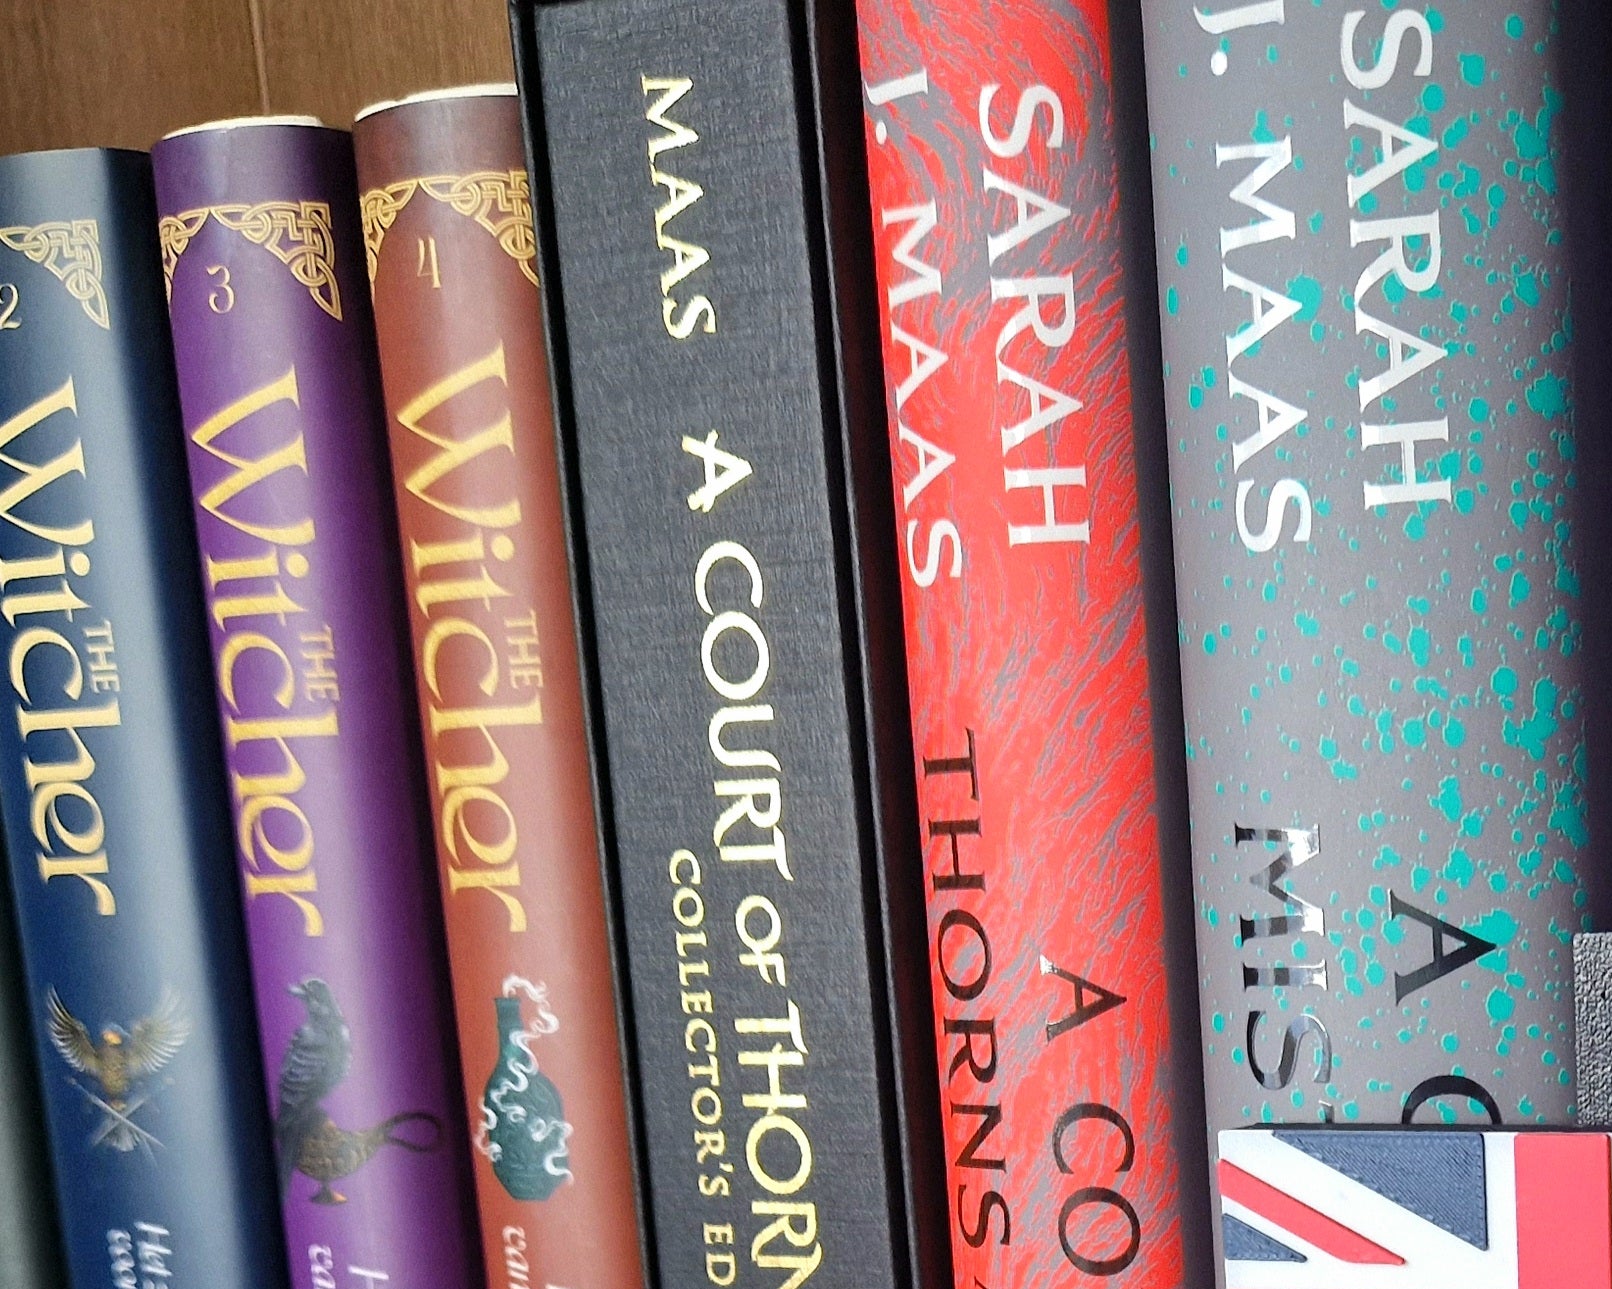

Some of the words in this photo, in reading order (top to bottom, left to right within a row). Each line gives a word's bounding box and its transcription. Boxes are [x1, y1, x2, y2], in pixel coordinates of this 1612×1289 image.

[864, 68, 929, 145] J.
[1192, 0, 1285, 77] J.
[205, 264, 235, 314] 3
[415, 236, 443, 290] 4
[640, 73, 716, 341] MAAS
[1340, 9, 1453, 511] SARAH
[0, 283, 22, 330] 2
[881, 202, 963, 590] MAAS
[979, 84, 1091, 547] SARAH
[1215, 134, 1313, 555] MAAS
[682, 430, 753, 513] A
[0, 373, 121, 916] Witcher
[83, 620, 120, 695] THE
[192, 363, 340, 937] Witcher
[301, 625, 340, 702] THE
[397, 339, 543, 932] Witcher
[503, 609, 544, 691] THE
[694, 540, 793, 881] COURT
[669, 848, 735, 1198] COLLECTOR'S
[735, 893, 787, 987] OF
[922, 727, 1012, 1250] THORNS
[1039, 954, 1128, 1043] A
[1233, 821, 1335, 1124] MIS
[1388, 887, 1498, 1008] A
